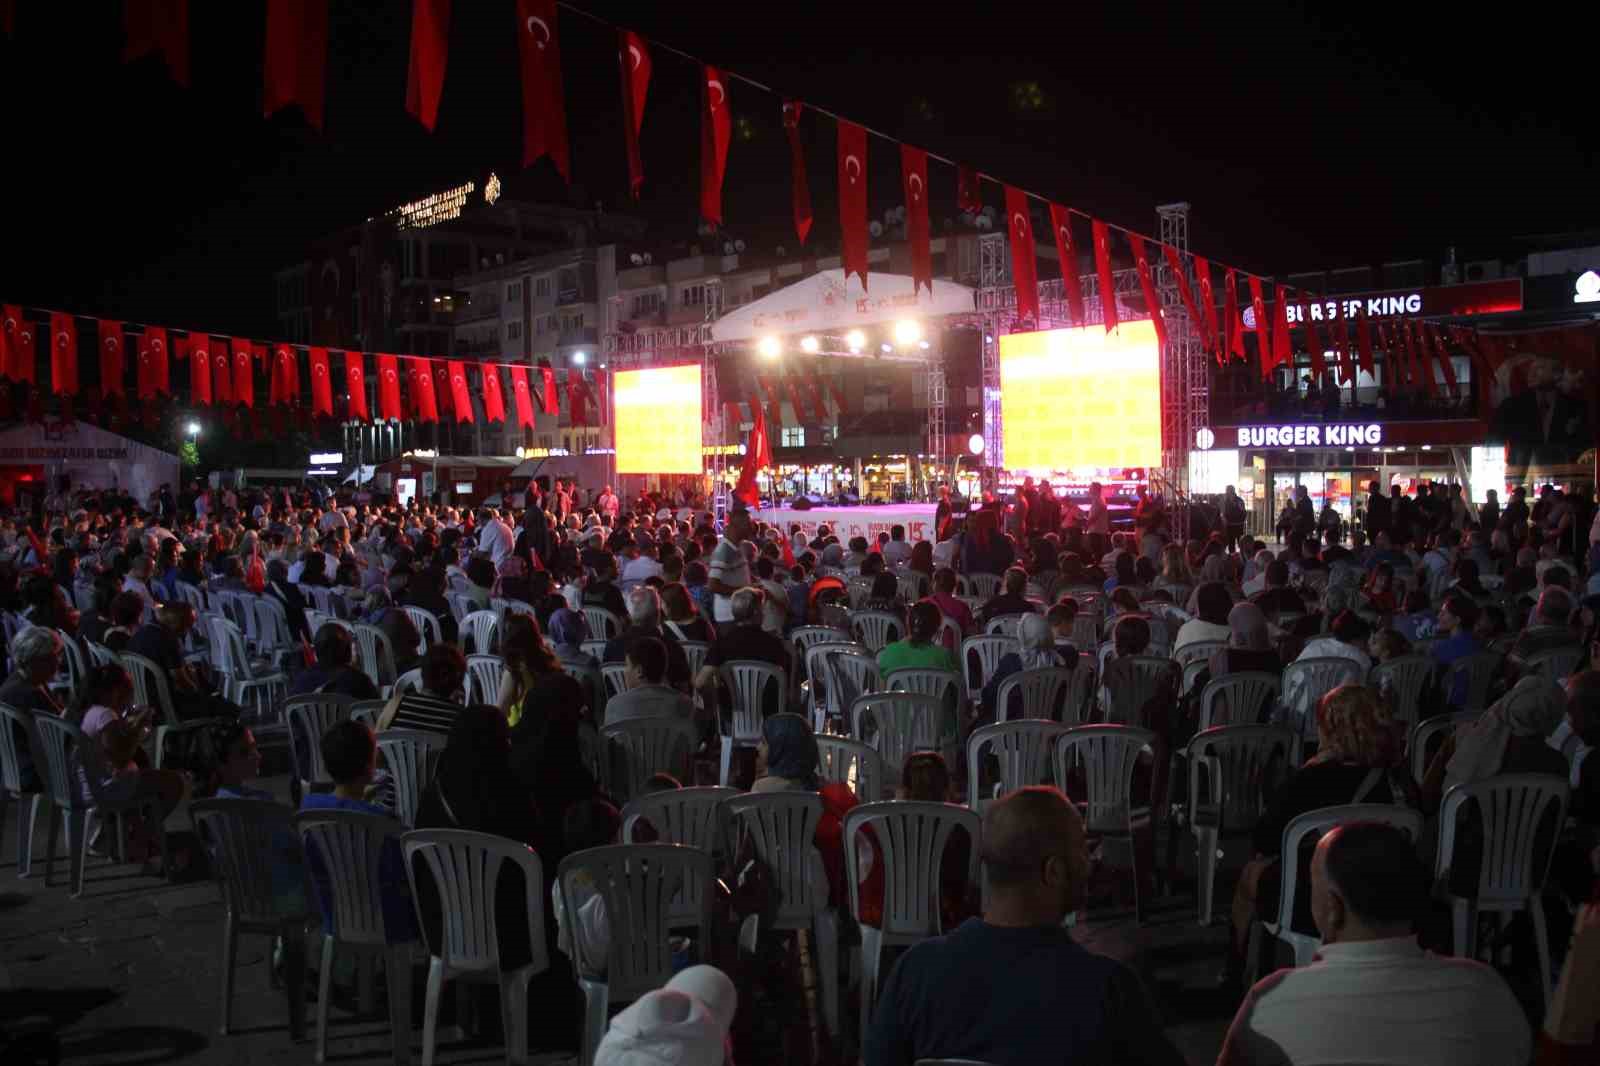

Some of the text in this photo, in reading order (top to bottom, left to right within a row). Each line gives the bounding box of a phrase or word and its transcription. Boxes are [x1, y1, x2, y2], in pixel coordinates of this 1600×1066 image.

[1367, 294, 1422, 317] KING
[1237, 424, 1382, 447] BURGER KING
